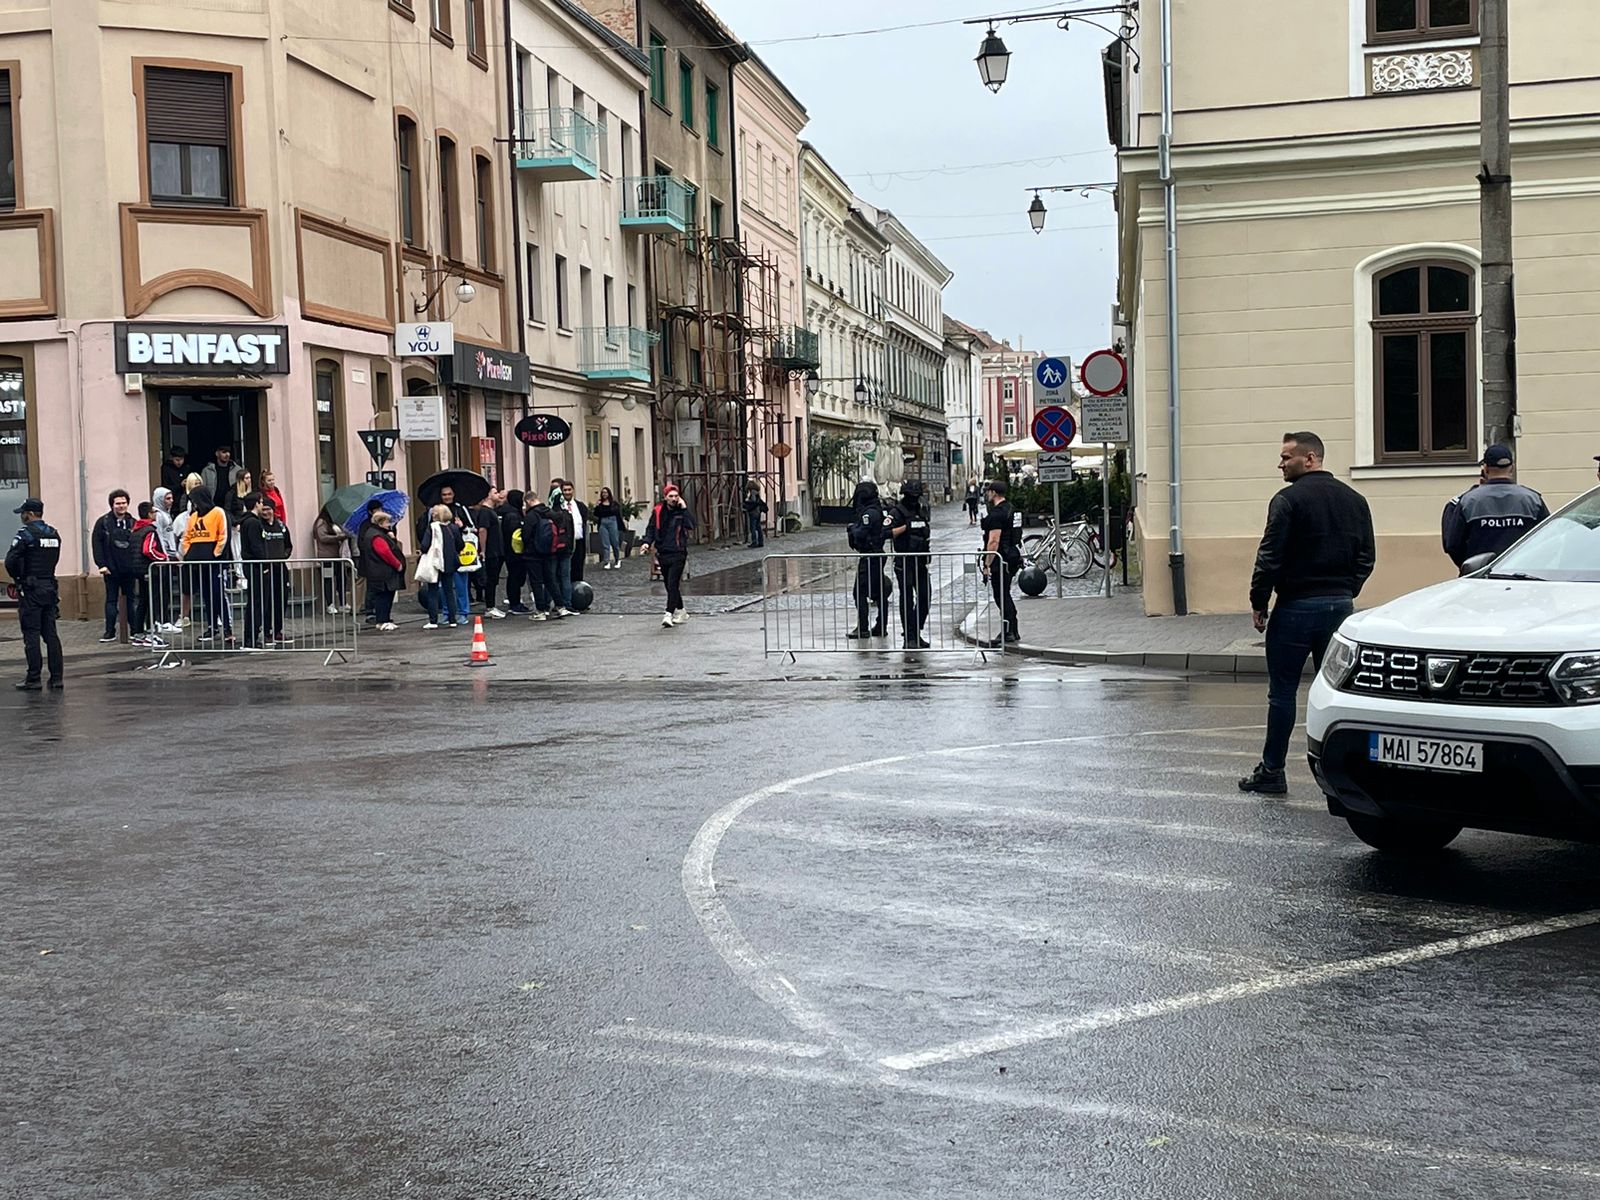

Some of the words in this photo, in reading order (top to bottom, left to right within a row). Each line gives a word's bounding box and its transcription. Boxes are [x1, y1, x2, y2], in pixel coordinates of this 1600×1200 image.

[418, 327, 428, 338] 4
[127, 332, 282, 364] BENFAST
[408, 341, 439, 352] YOU
[0, 437, 21, 445] CHIS!
[1382, 737, 1410, 762] MAI
[1417, 740, 1476, 769] 57864
